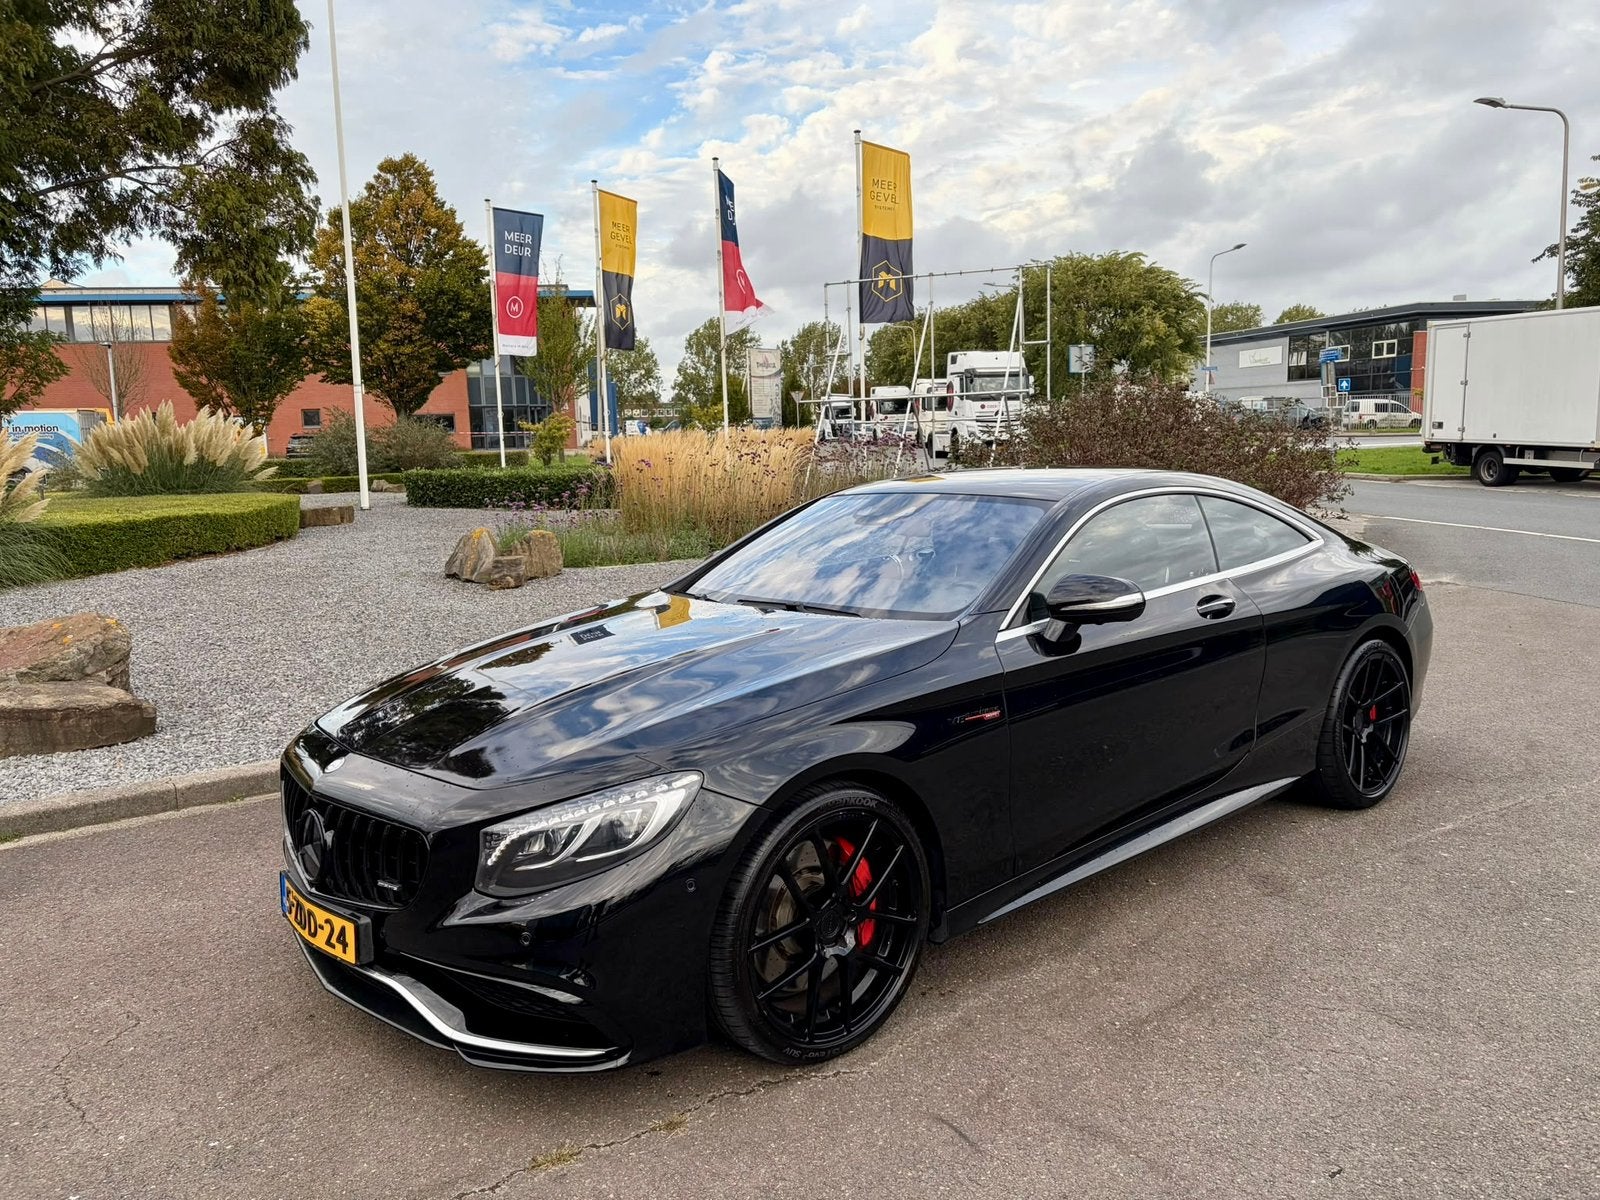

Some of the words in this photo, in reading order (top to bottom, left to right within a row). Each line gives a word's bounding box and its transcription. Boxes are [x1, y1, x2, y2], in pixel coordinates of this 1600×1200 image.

[612, 221, 631, 234] MEER
[504, 231, 533, 245] MEER
[610, 231, 633, 245] GEVEL
[504, 244, 532, 257] DEUR
